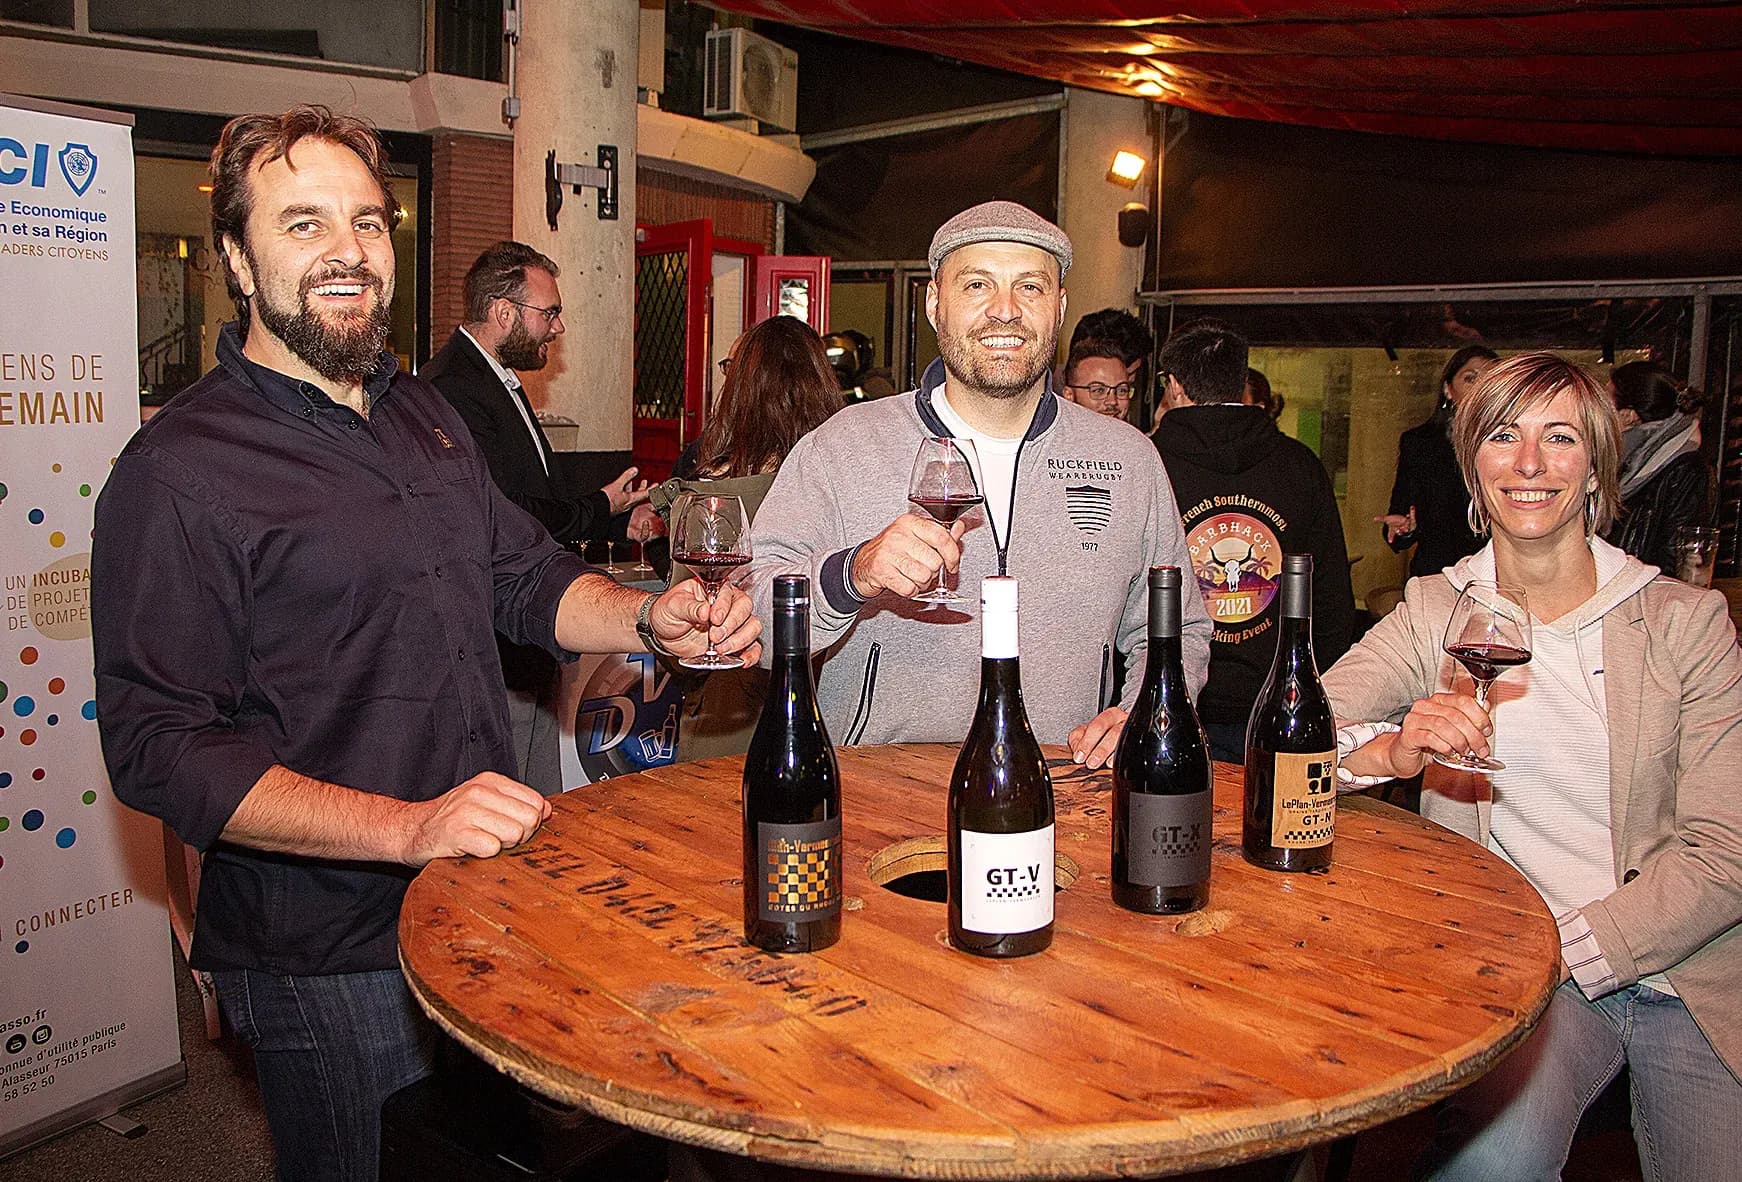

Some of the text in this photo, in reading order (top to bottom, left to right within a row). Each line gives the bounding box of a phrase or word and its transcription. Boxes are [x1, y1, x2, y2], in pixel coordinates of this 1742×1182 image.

[11, 200, 107, 223] Economique
[12, 222, 28, 235] et
[32, 225, 50, 238] sa
[55, 224, 107, 243] Région
[1, 243, 109, 260] ADERS CITOYENS
[2, 353, 103, 381] ENS DE
[0, 391, 104, 425] EMAIN
[1047, 458, 1123, 471] RUCKFIELD
[1213, 493, 1288, 533] Southernmost
[1081, 542, 1099, 552] 1977
[1188, 521, 1272, 556] BARBHACK
[5, 568, 91, 590] UN INCUBA
[7, 587, 89, 611] DE PROJET
[1215, 596, 1252, 617] 2021
[8, 604, 91, 631] DE COMPÉ
[1242, 617, 1273, 640] Event
[1302, 811, 1332, 826] GT-N
[986, 863, 1041, 886] GT-V
[15, 888, 134, 936] CONNECTER
[0, 1008, 47, 1034] asso.fr
[36, 1037, 79, 1061] d'utilité
[82, 1022, 127, 1047] publique
[1, 1039, 117, 1089] Alasseur 75015 Paris
[4, 1074, 55, 1102] 58 52 50
